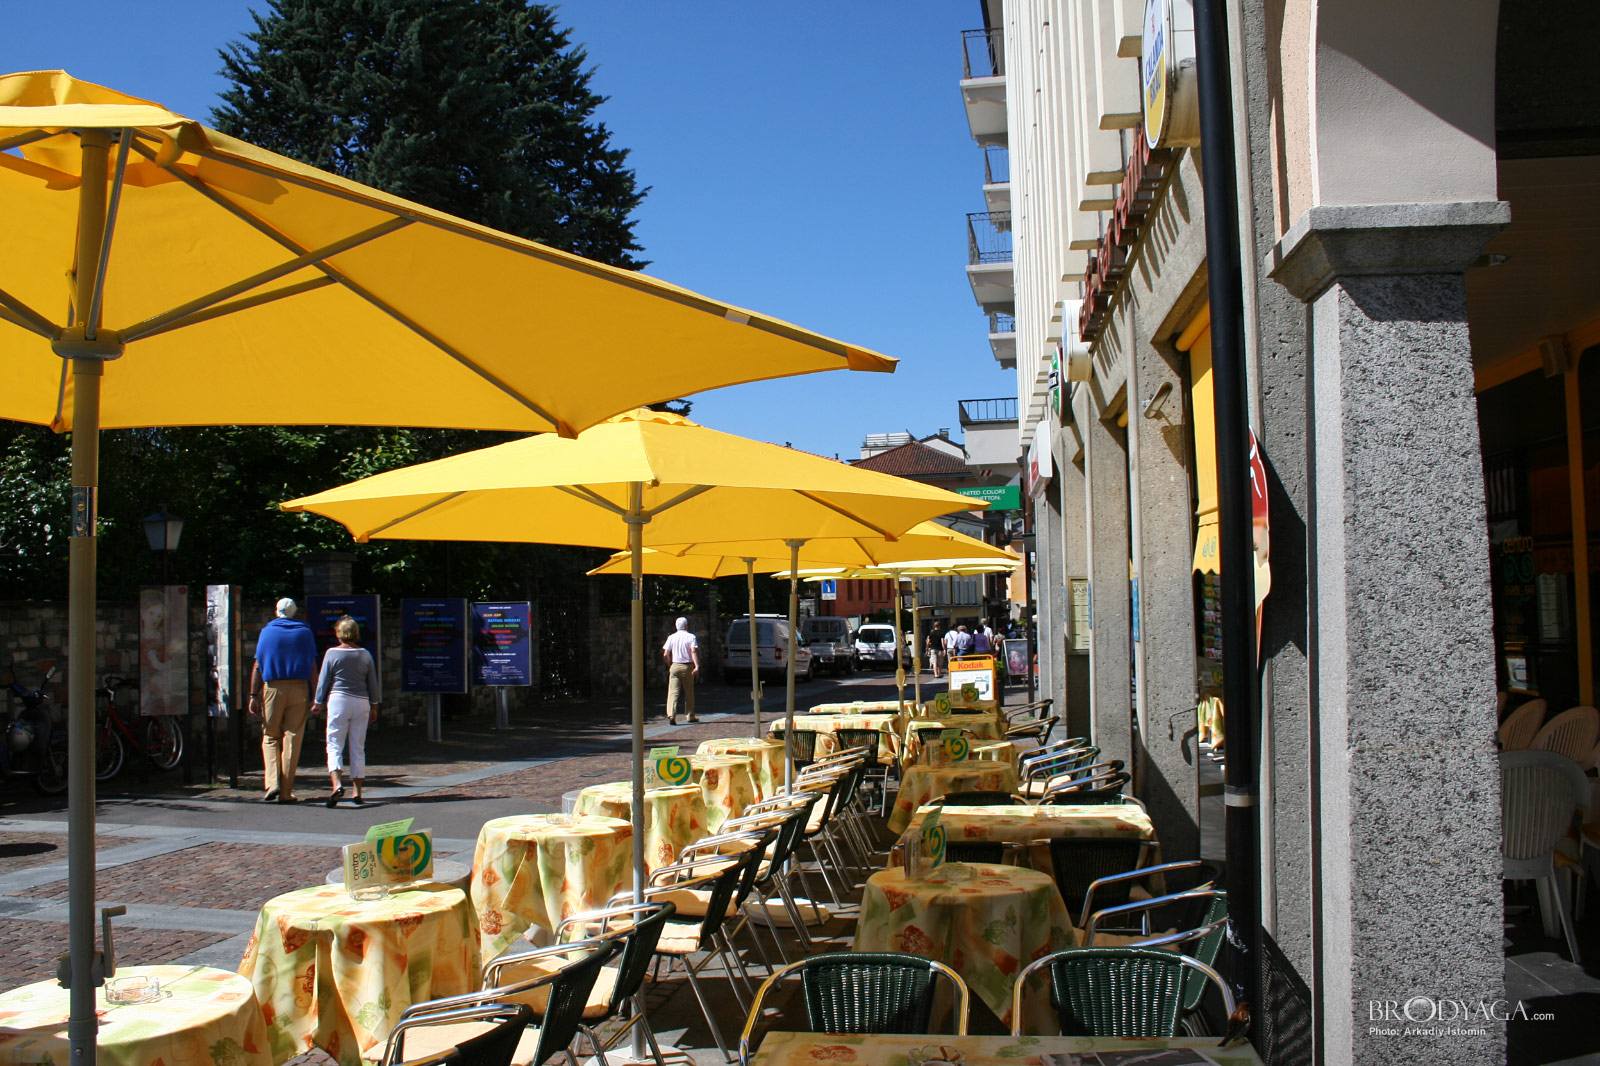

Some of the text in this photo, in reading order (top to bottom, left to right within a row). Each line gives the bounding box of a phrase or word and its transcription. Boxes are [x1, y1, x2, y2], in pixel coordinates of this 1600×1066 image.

[1145, 22, 1164, 87] CALANDA
[957, 661, 984, 670] Kodak
[352, 852, 360, 881] centro
